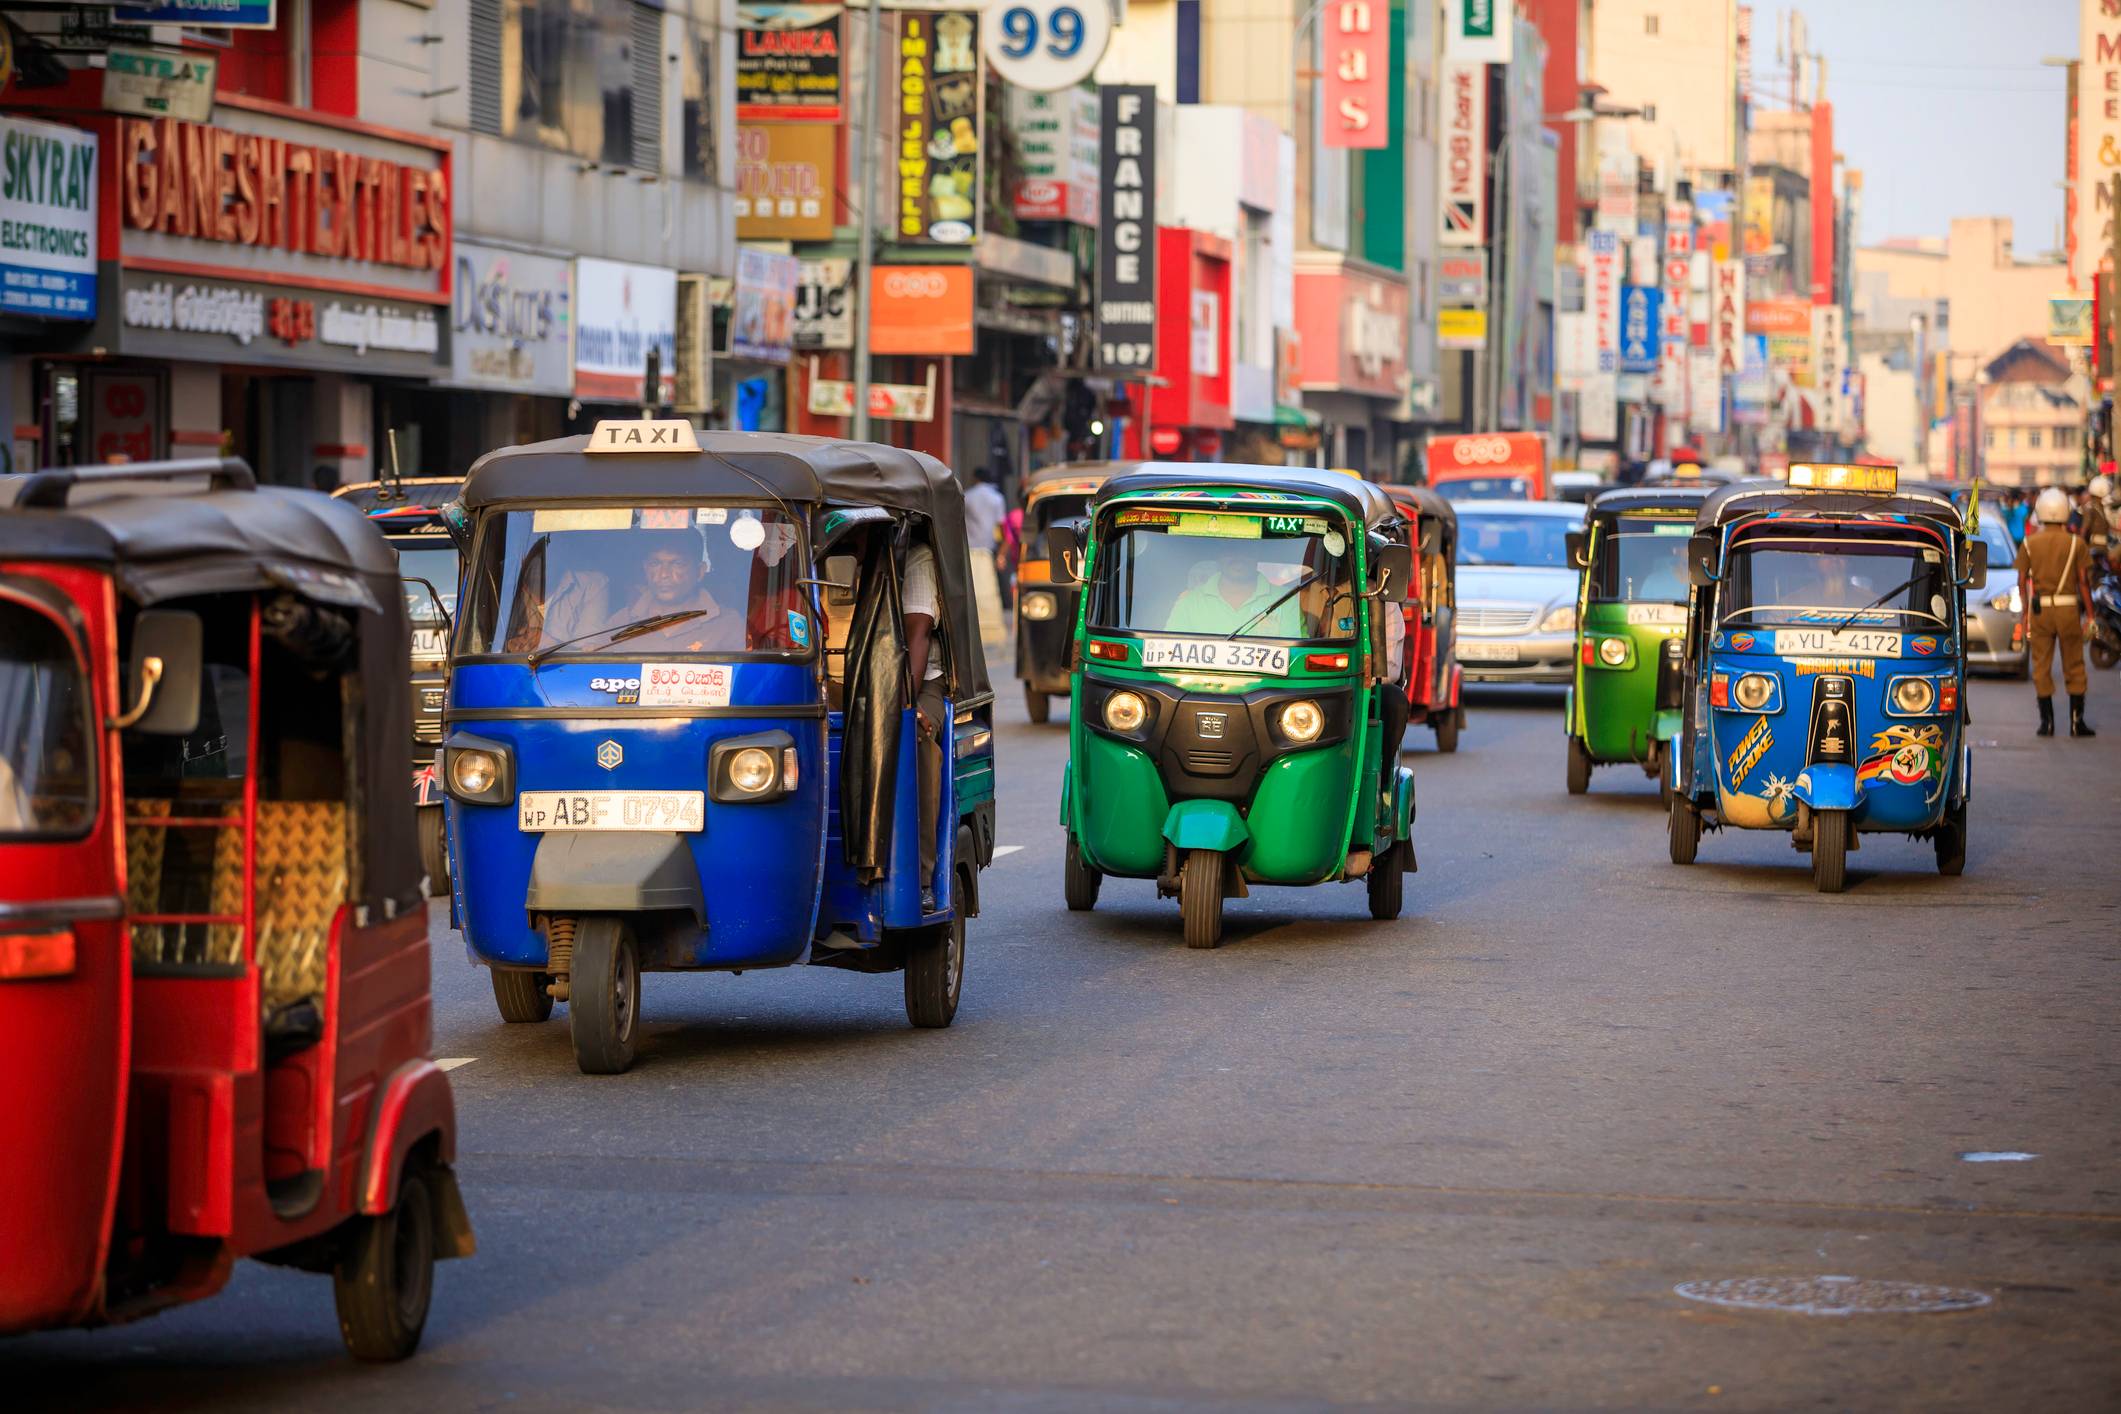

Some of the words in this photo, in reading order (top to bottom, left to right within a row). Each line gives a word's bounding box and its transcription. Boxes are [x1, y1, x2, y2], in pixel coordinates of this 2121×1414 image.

[744, 31, 837, 56] LANKA
[1001, 7, 1086, 59] 99
[901, 18, 927, 115] IMAGE
[3, 130, 95, 211] SKYRAY
[899, 120, 927, 236] JEWELS
[1113, 93, 1143, 283] FRANCE
[125, 118, 286, 247] GANESH
[286, 145, 448, 271] TEXTILES
[1, 220, 88, 258] ELECTRONICS
[1102, 343, 1151, 365] 107
[605, 427, 679, 444] TAXI
[1169, 643, 1216, 664] AAQ
[1226, 645, 1285, 669] 3376
[1799, 633, 1824, 649] YU
[1848, 635, 1898, 653] 4172
[590, 678, 640, 692] ape
[1728, 715, 1768, 774] POWER
[1731, 728, 1775, 793] STROKE
[524, 811, 545, 826] WP
[553, 798, 610, 825] ABF
[623, 797, 698, 825] 0794
